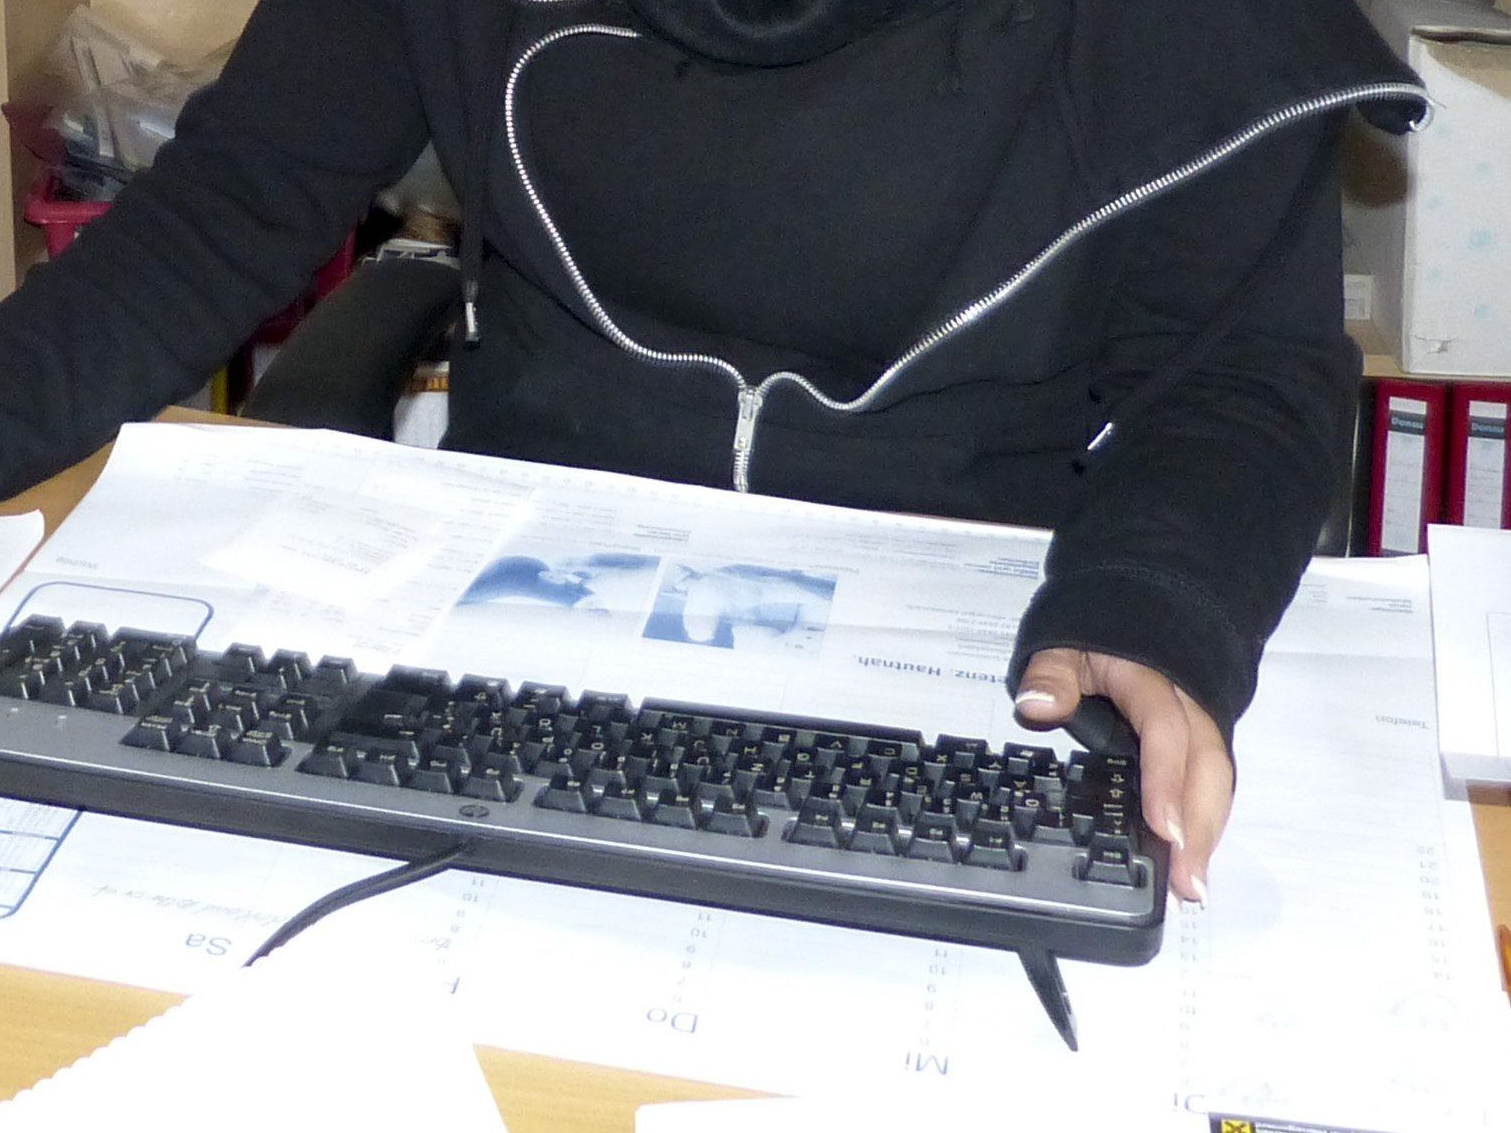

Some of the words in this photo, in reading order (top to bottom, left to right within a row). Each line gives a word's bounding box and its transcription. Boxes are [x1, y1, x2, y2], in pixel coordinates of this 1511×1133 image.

[853, 656, 941, 676] Hautnah.
[949, 669, 1009, 684] etenz.
[1375, 715, 1430, 731] Telefon
[185, 933, 232, 956] Sa
[646, 1008, 698, 1034] Do
[905, 1052, 949, 1076] Mi
